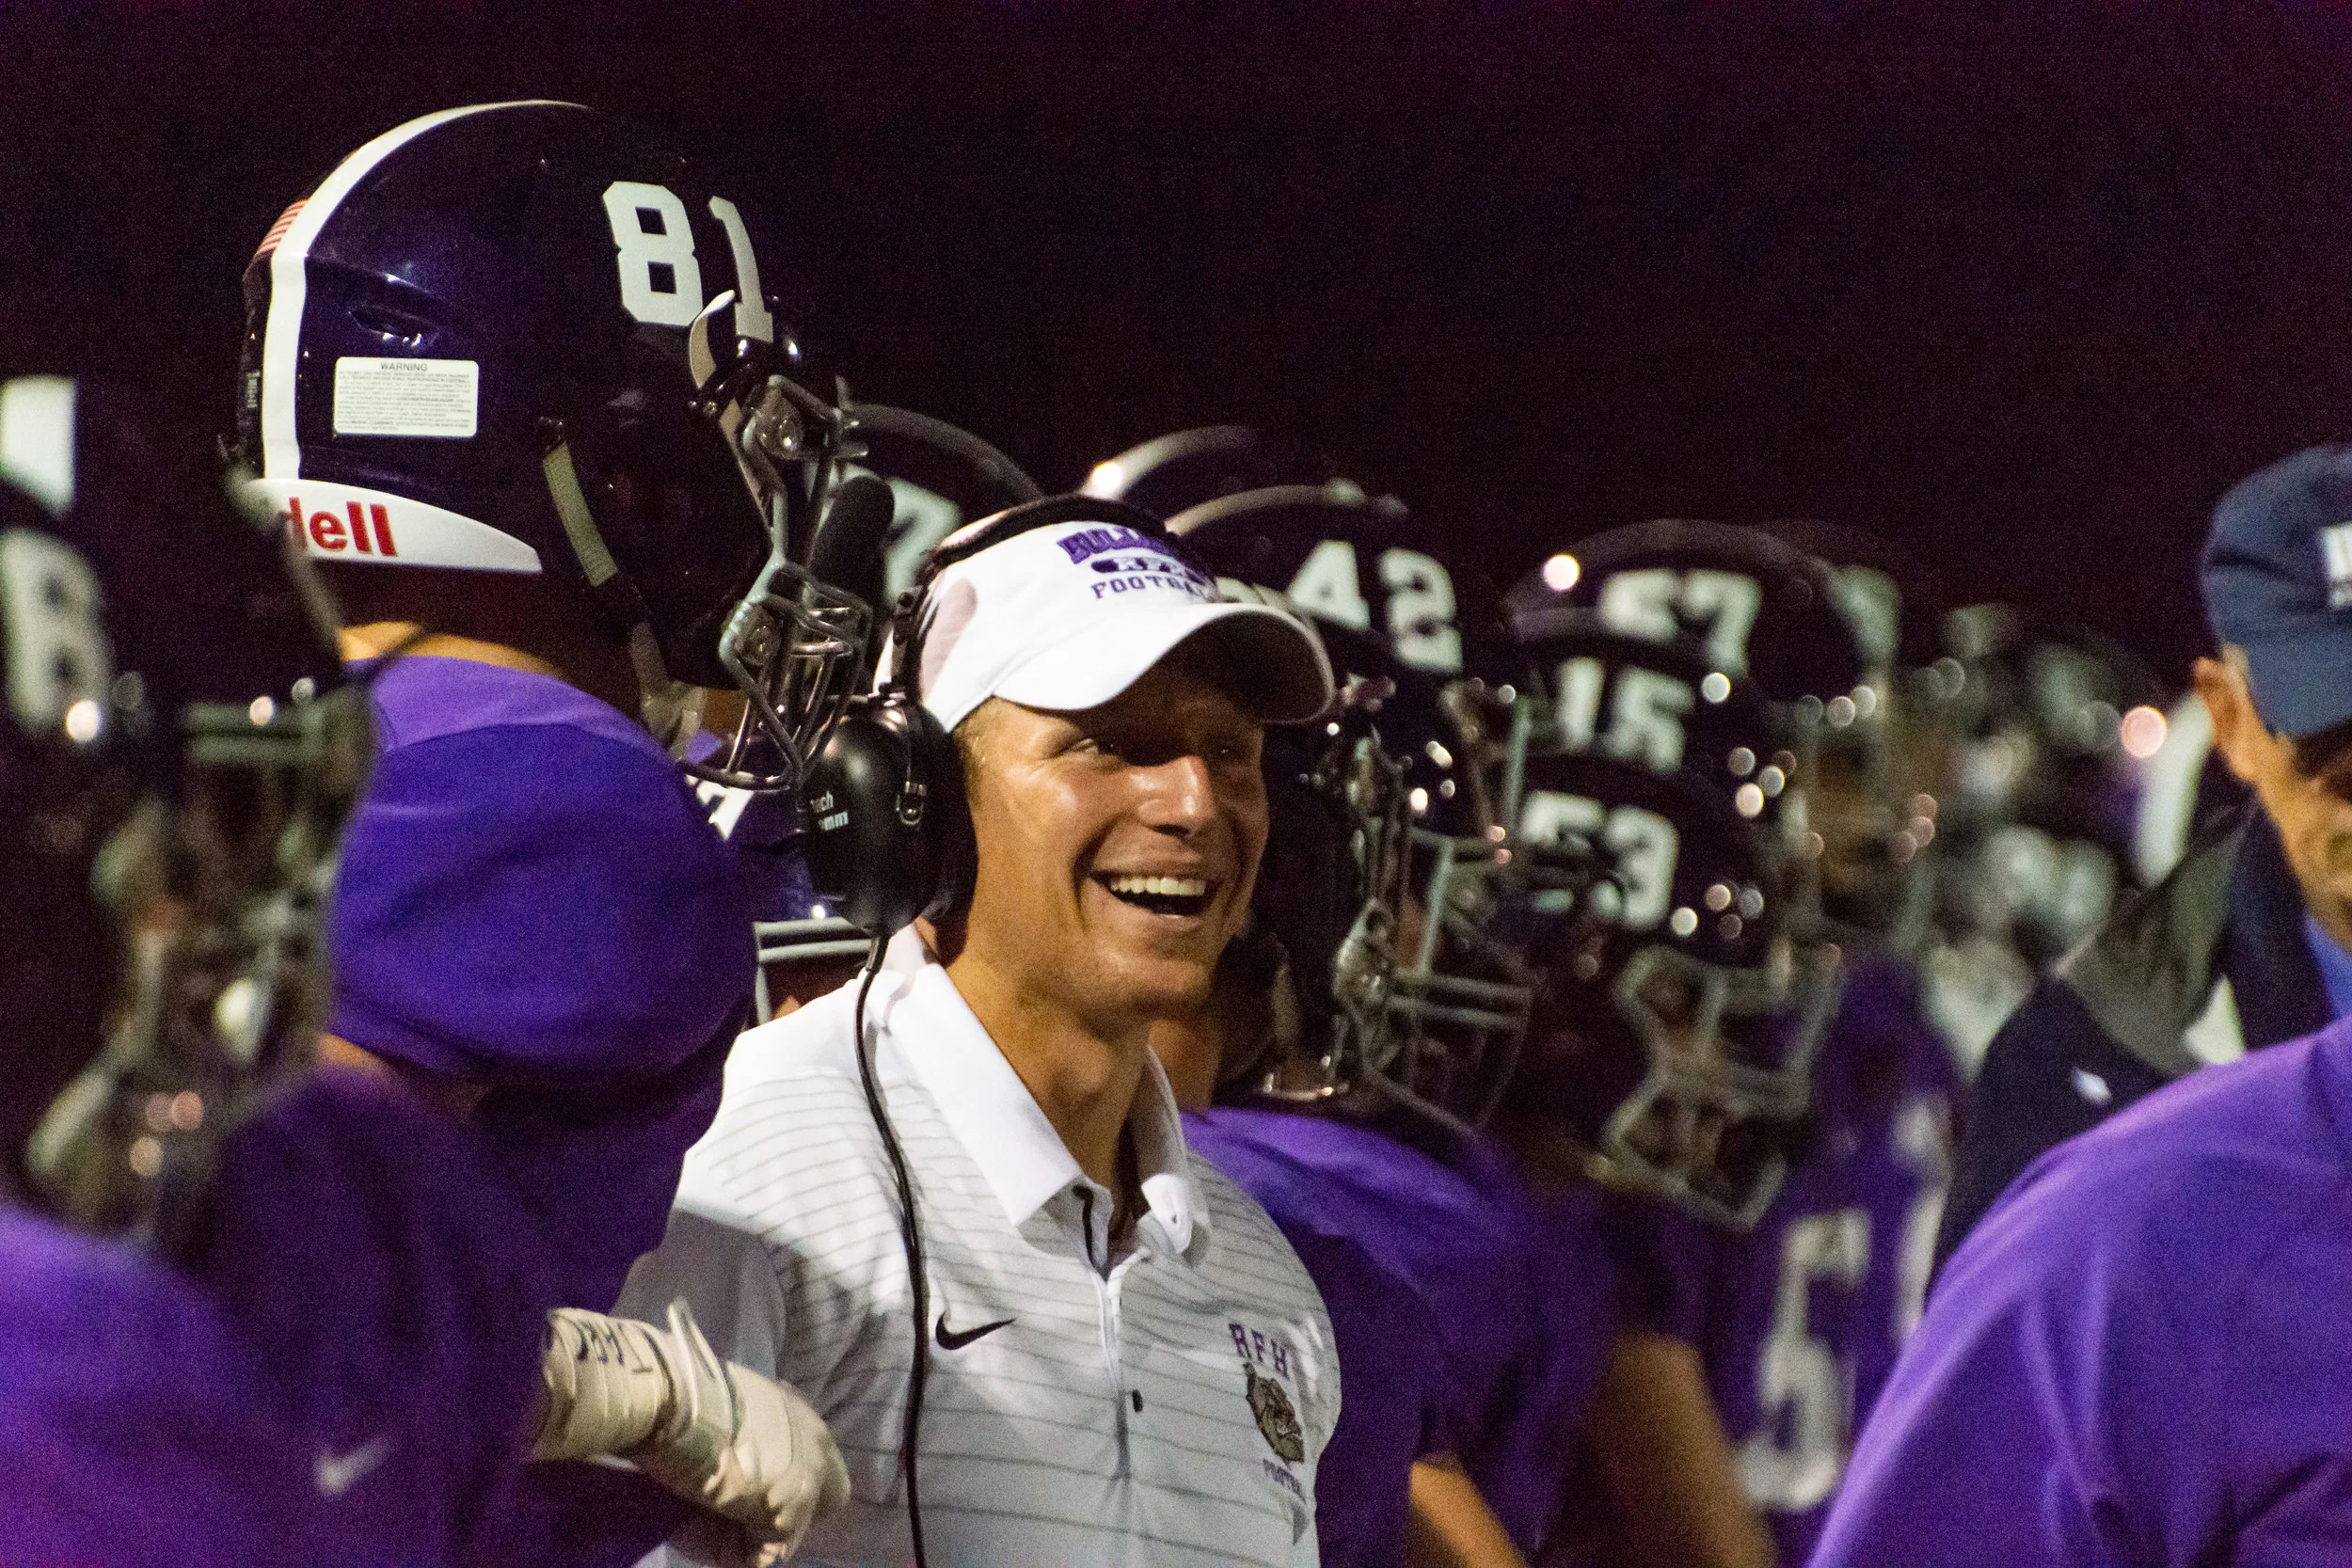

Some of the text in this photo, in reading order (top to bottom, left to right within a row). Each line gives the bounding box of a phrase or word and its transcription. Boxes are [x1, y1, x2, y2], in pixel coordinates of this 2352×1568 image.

[602, 181, 773, 344] 81
[380, 362, 428, 372] WARNING
[1287, 538, 1464, 675] 42
[1229, 1323, 1291, 1382] RFH
